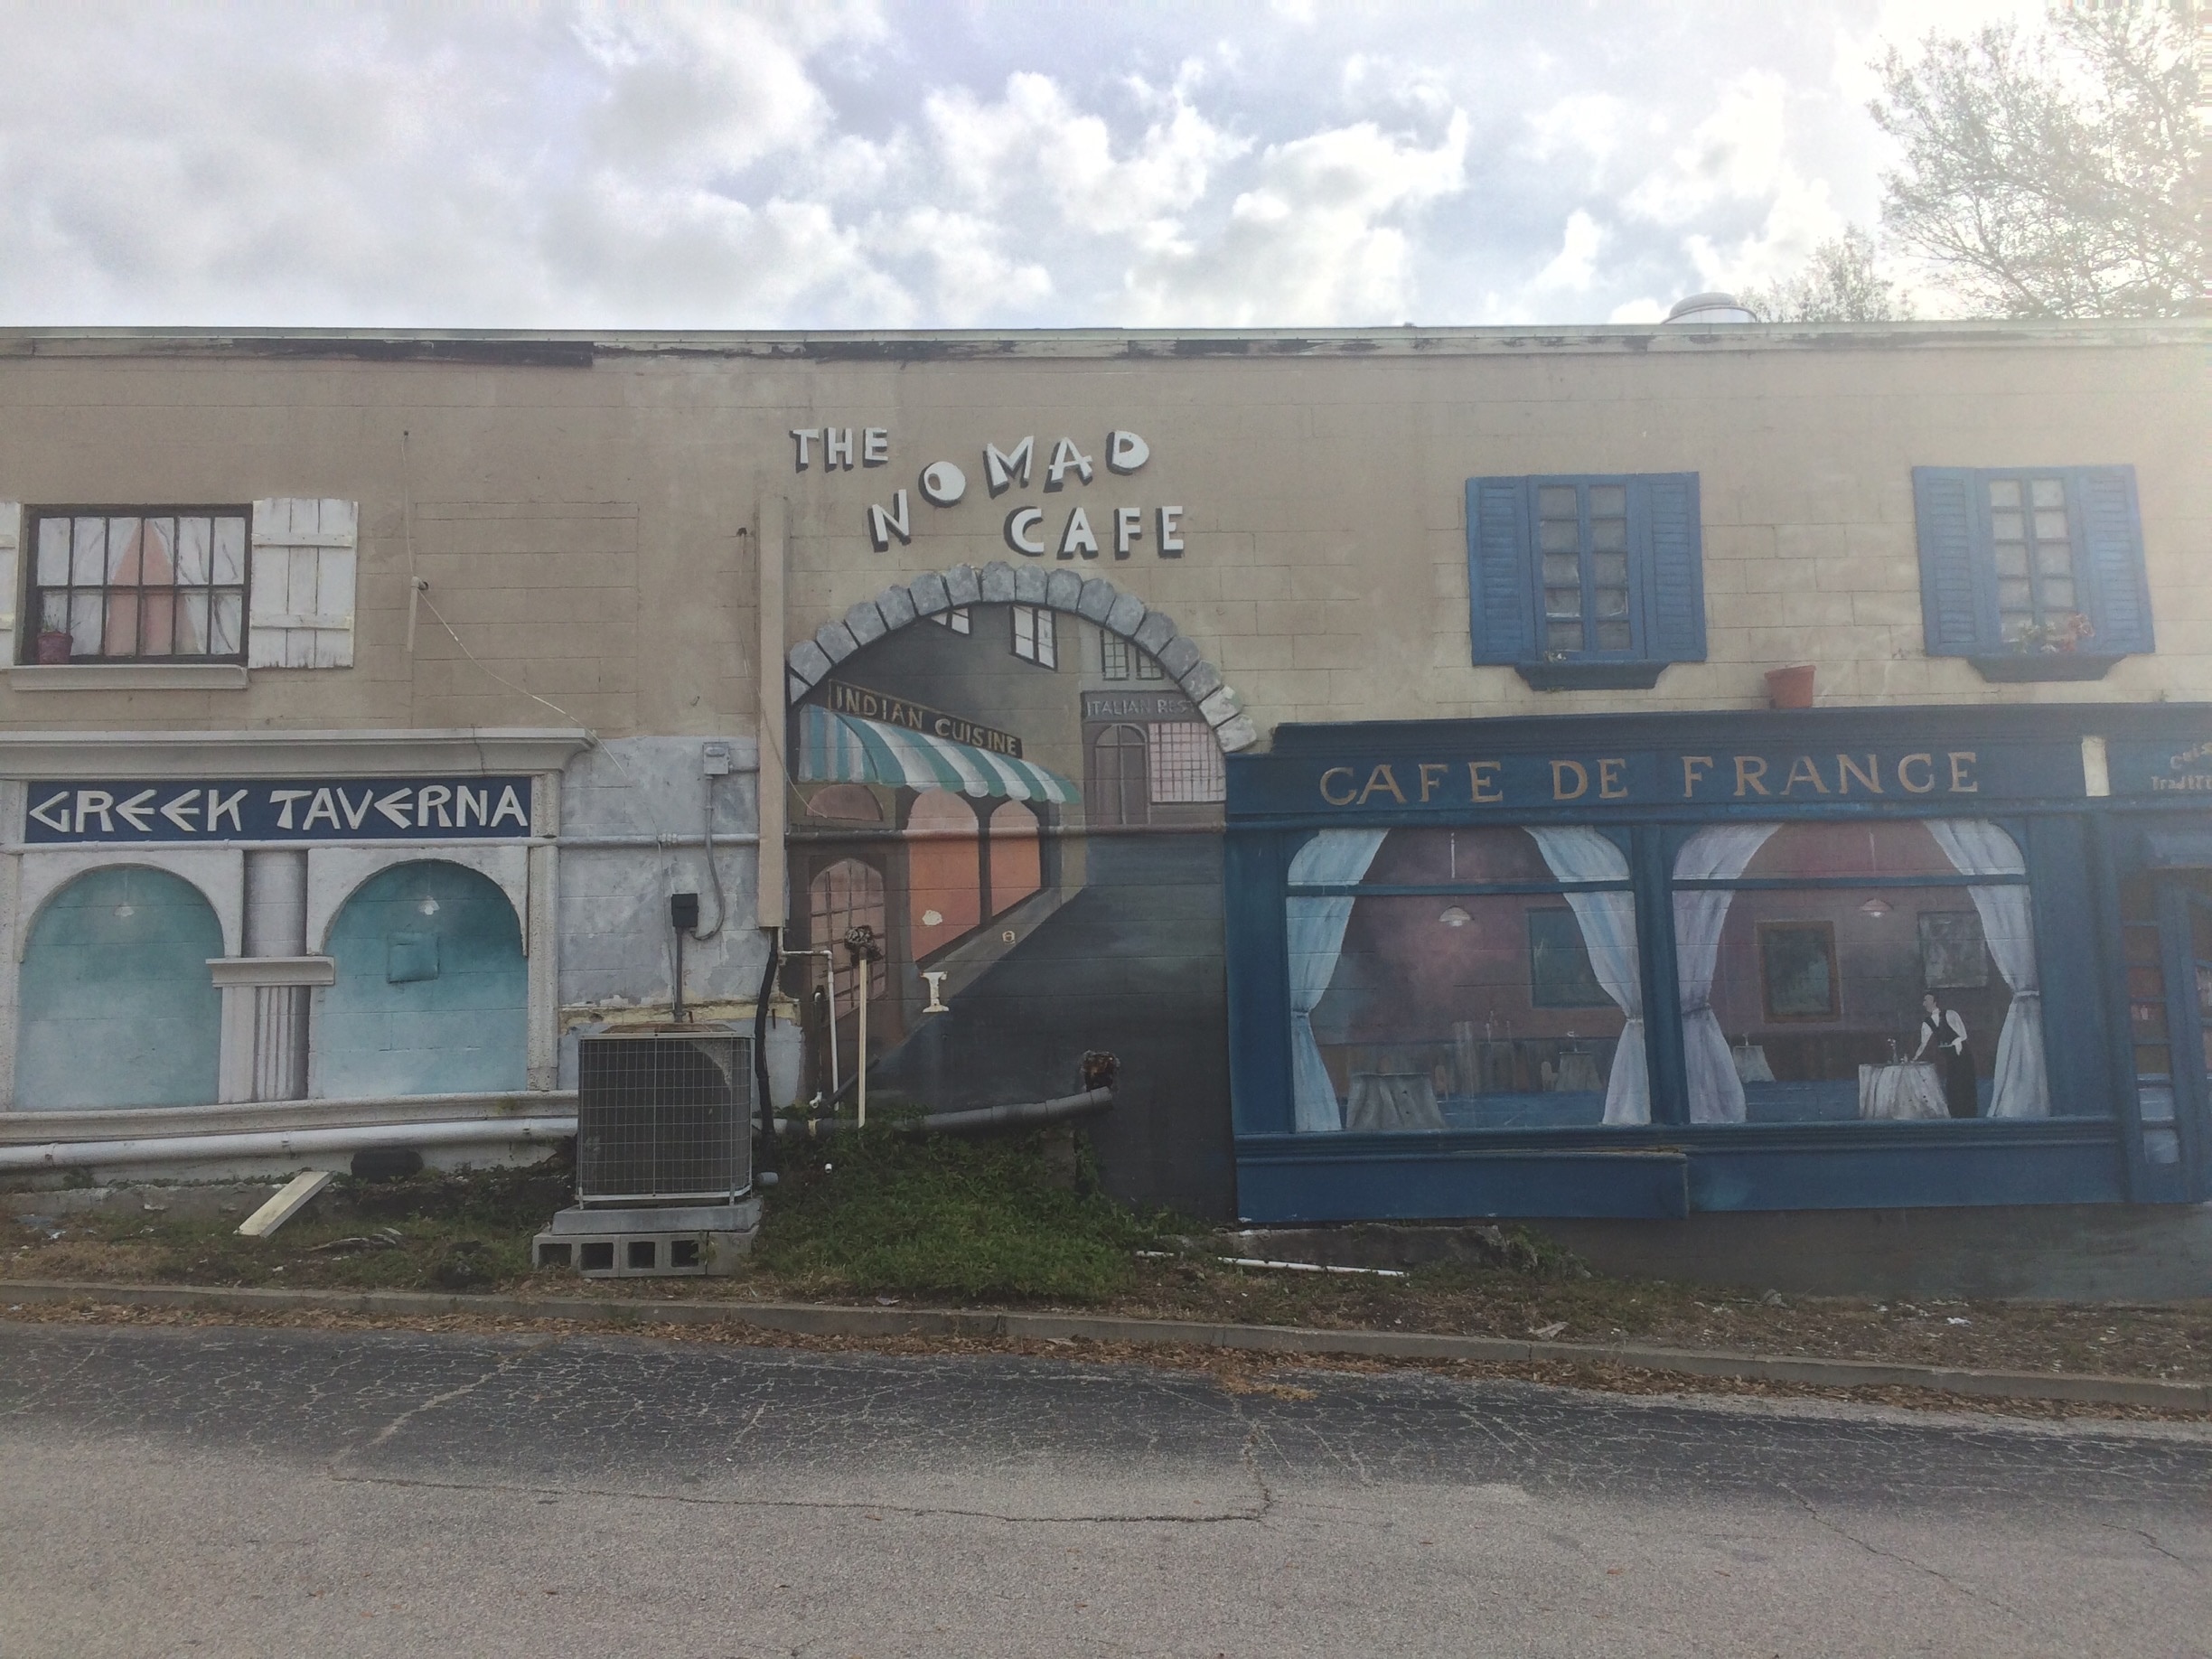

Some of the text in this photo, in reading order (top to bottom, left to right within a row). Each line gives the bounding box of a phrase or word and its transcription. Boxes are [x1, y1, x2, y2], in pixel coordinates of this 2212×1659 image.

[791, 426, 888, 467] THE
[870, 429, 1150, 548] NOMAD
[1007, 506, 1185, 555] CAFE
[836, 686, 1017, 755] INDIAN CUISINE
[1087, 699, 1151, 717] ITALIAN
[1319, 751, 1979, 806] CAFE DE FRANCE
[29, 784, 528, 833] GREEK TAVERNA
